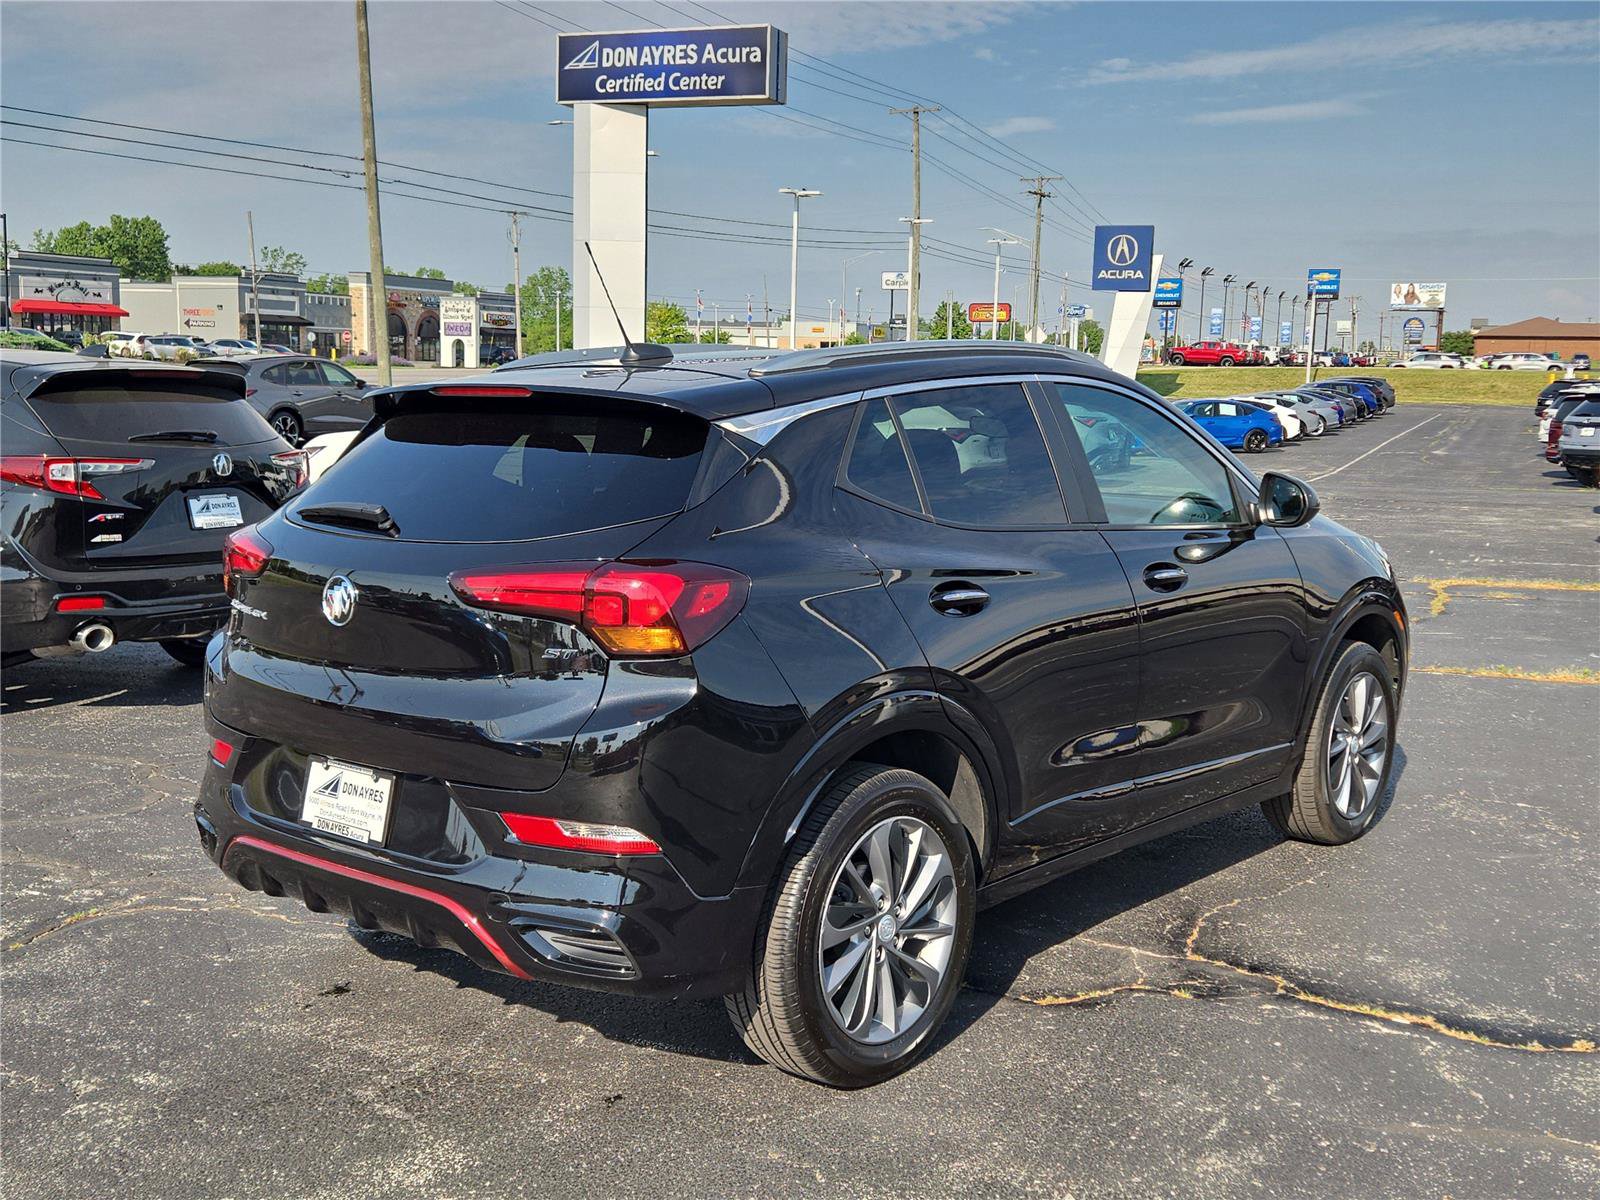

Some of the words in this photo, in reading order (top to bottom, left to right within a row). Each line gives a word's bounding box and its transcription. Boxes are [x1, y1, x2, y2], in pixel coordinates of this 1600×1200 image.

[602, 46, 638, 68] DON
[640, 44, 698, 66] AYRES
[702, 43, 762, 64] Acura
[595, 72, 666, 93] Certified
[669, 72, 726, 91] Center
[1097, 269, 1145, 279] ACURA
[541, 648, 579, 660] ST
[342, 782, 359, 797] DON
[358, 786, 384, 804] AYRES
[317, 818, 330, 830] DON
[330, 822, 349, 837] AYRES
